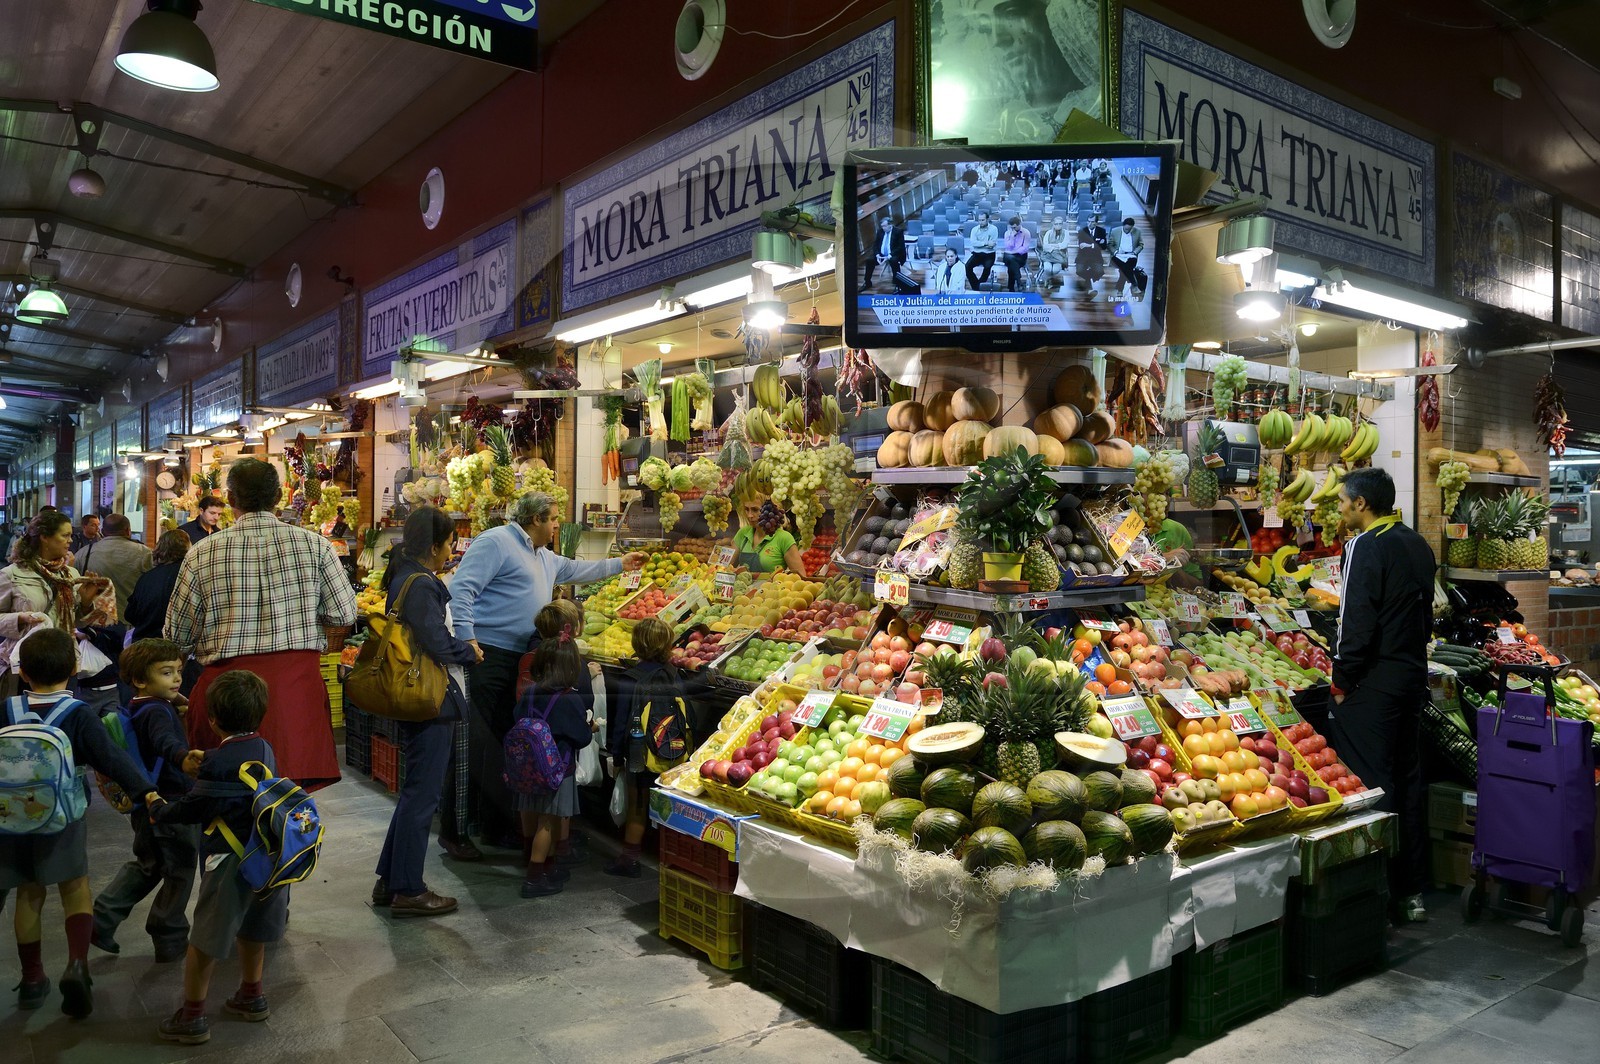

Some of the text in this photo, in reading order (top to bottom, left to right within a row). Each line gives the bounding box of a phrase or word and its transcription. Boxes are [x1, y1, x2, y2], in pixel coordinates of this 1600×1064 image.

[293, 0, 492, 52] RECCIÓN
[847, 71, 871, 109] Nº
[847, 109, 869, 143] 45
[1155, 80, 1402, 241] MORA TRIANA
[1122, 167, 1145, 175] 10:32
[580, 104, 835, 272] MORA TRIANA
[1408, 195, 1422, 222] 45
[369, 300, 411, 354] FRUTAS
[411, 292, 423, 336] Y
[422, 258, 497, 333] VERDURAS
[871, 296, 1026, 308] Isabel y Julián, del amor al desamor
[883, 306, 1051, 318] Dice que siempre estuvo pendiente de Muñoz
[894, 316, 902, 325] el
[904, 316, 920, 324] duro
[922, 316, 958, 325] momento
[959, 316, 969, 324] de
[970, 315, 978, 324] la
[980, 315, 1007, 324] moción
[1009, 315, 1019, 323] de
[890, 583, 907, 601] 2'00
[925, 618, 954, 637] 2'50
[863, 713, 890, 733] 1'80
[1113, 715, 1141, 734] 2'40
[709, 826, 725, 843] SOL
